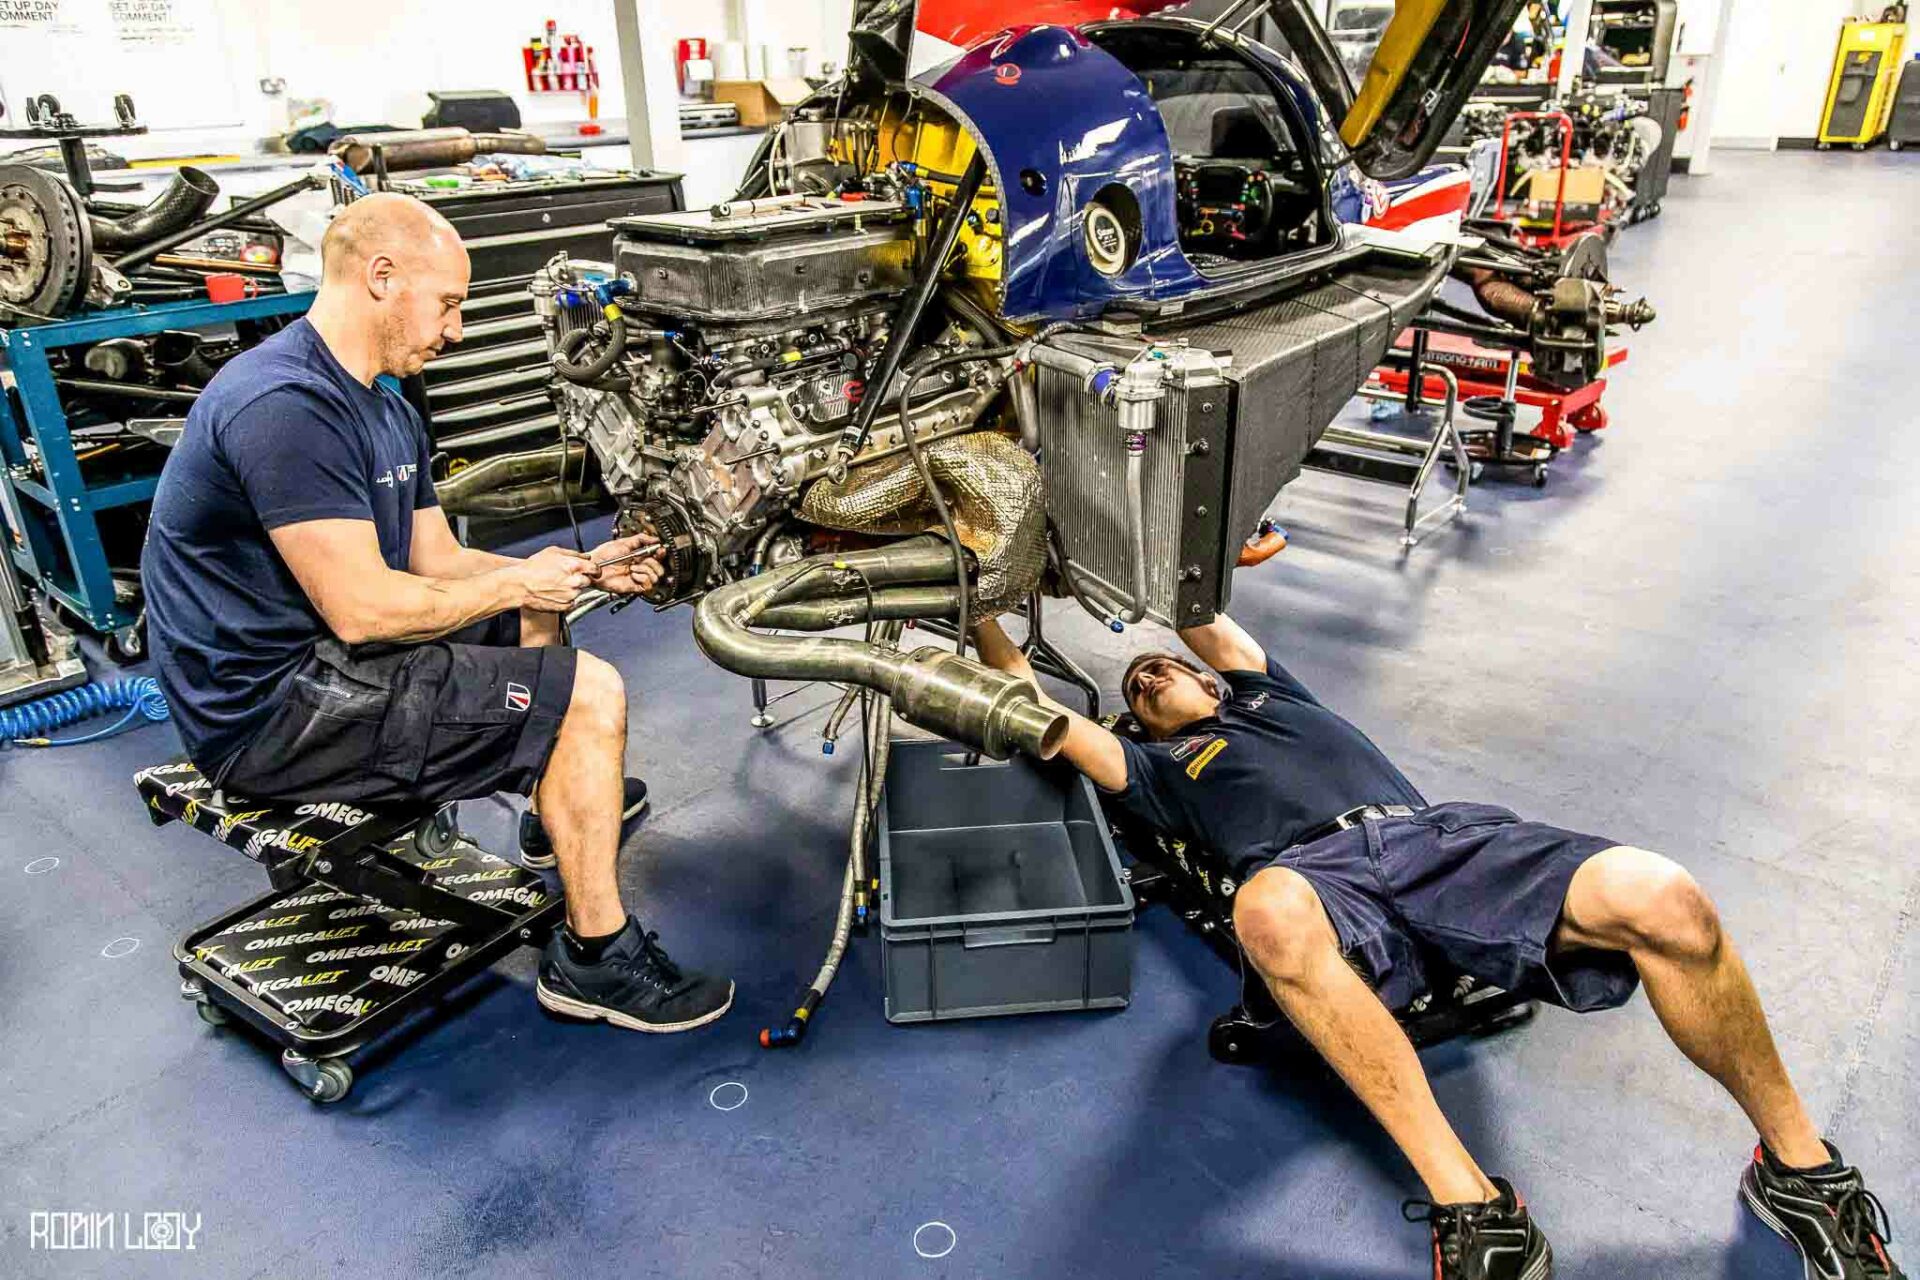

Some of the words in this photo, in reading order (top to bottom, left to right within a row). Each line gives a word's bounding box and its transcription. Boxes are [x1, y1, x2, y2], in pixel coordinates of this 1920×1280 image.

[14, 1, 31, 11] UP
[34, 1, 59, 11] DAY
[0, 10, 53, 21] OMMENT
[112, 13, 167, 22] COMMENT
[245, 925, 368, 951] OMEGALIFT
[306, 938, 433, 964] OMEGALIFT
